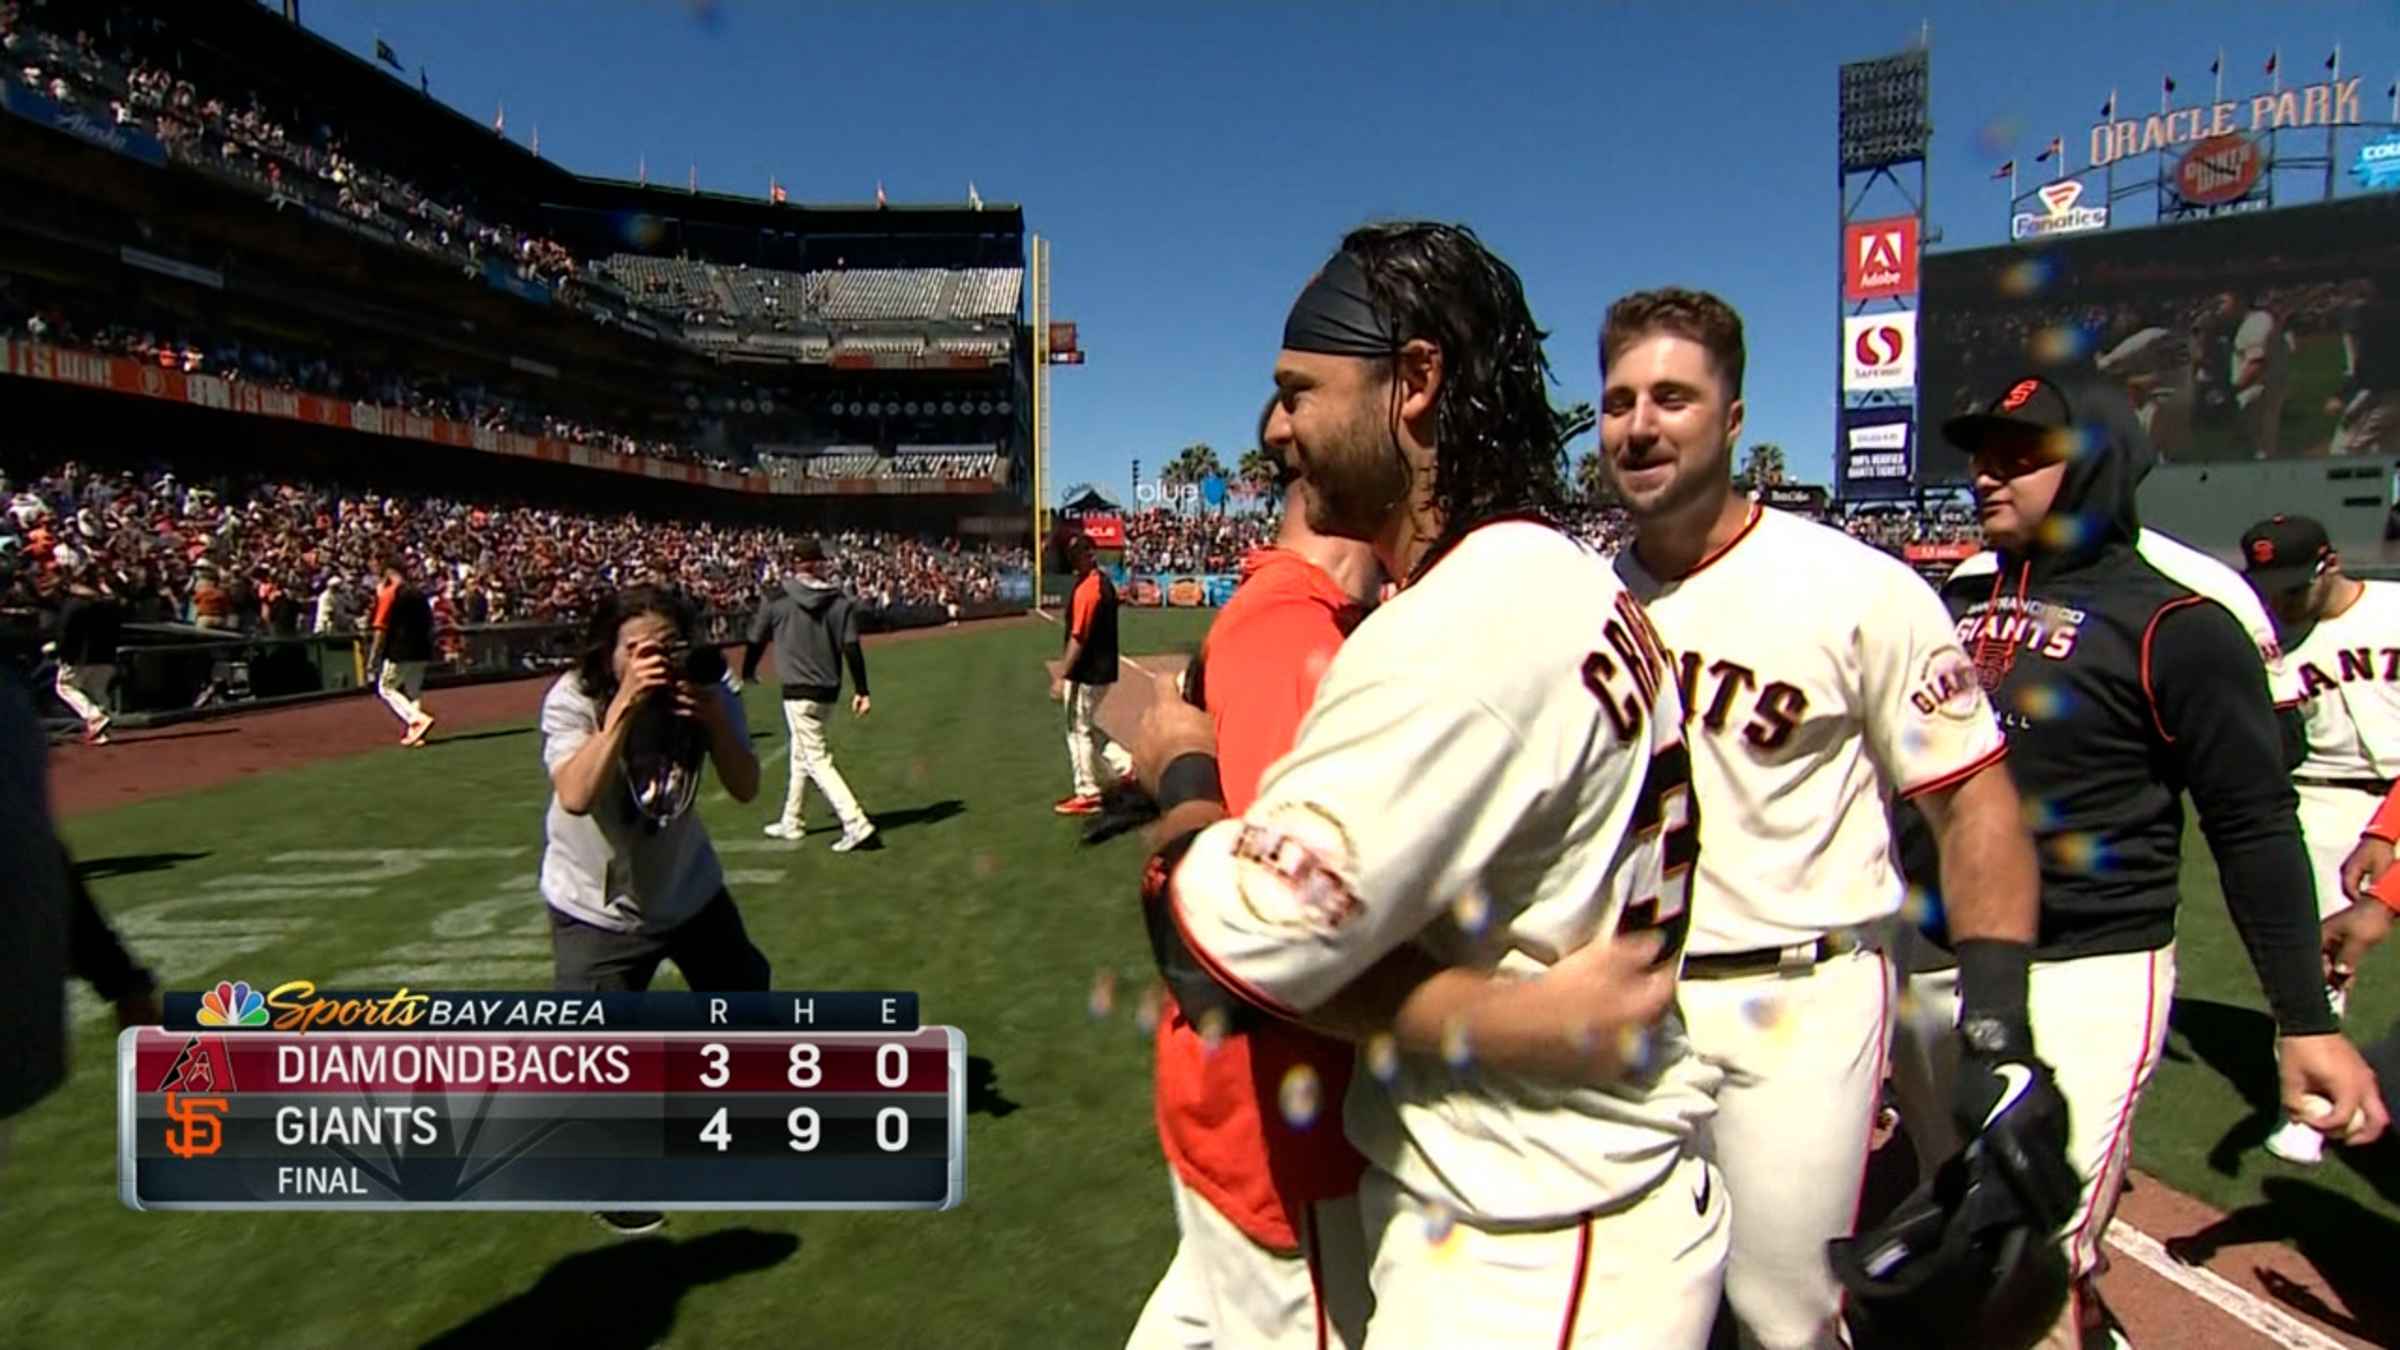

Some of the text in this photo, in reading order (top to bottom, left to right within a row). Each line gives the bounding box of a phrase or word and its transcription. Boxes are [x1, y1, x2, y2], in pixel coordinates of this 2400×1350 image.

[2090, 77, 2362, 167] ORACLE PARK
[2013, 208, 2107, 236] Fanatics
[1860, 272, 1900, 288] Adobe
[1955, 613, 2078, 660] GIANTS
